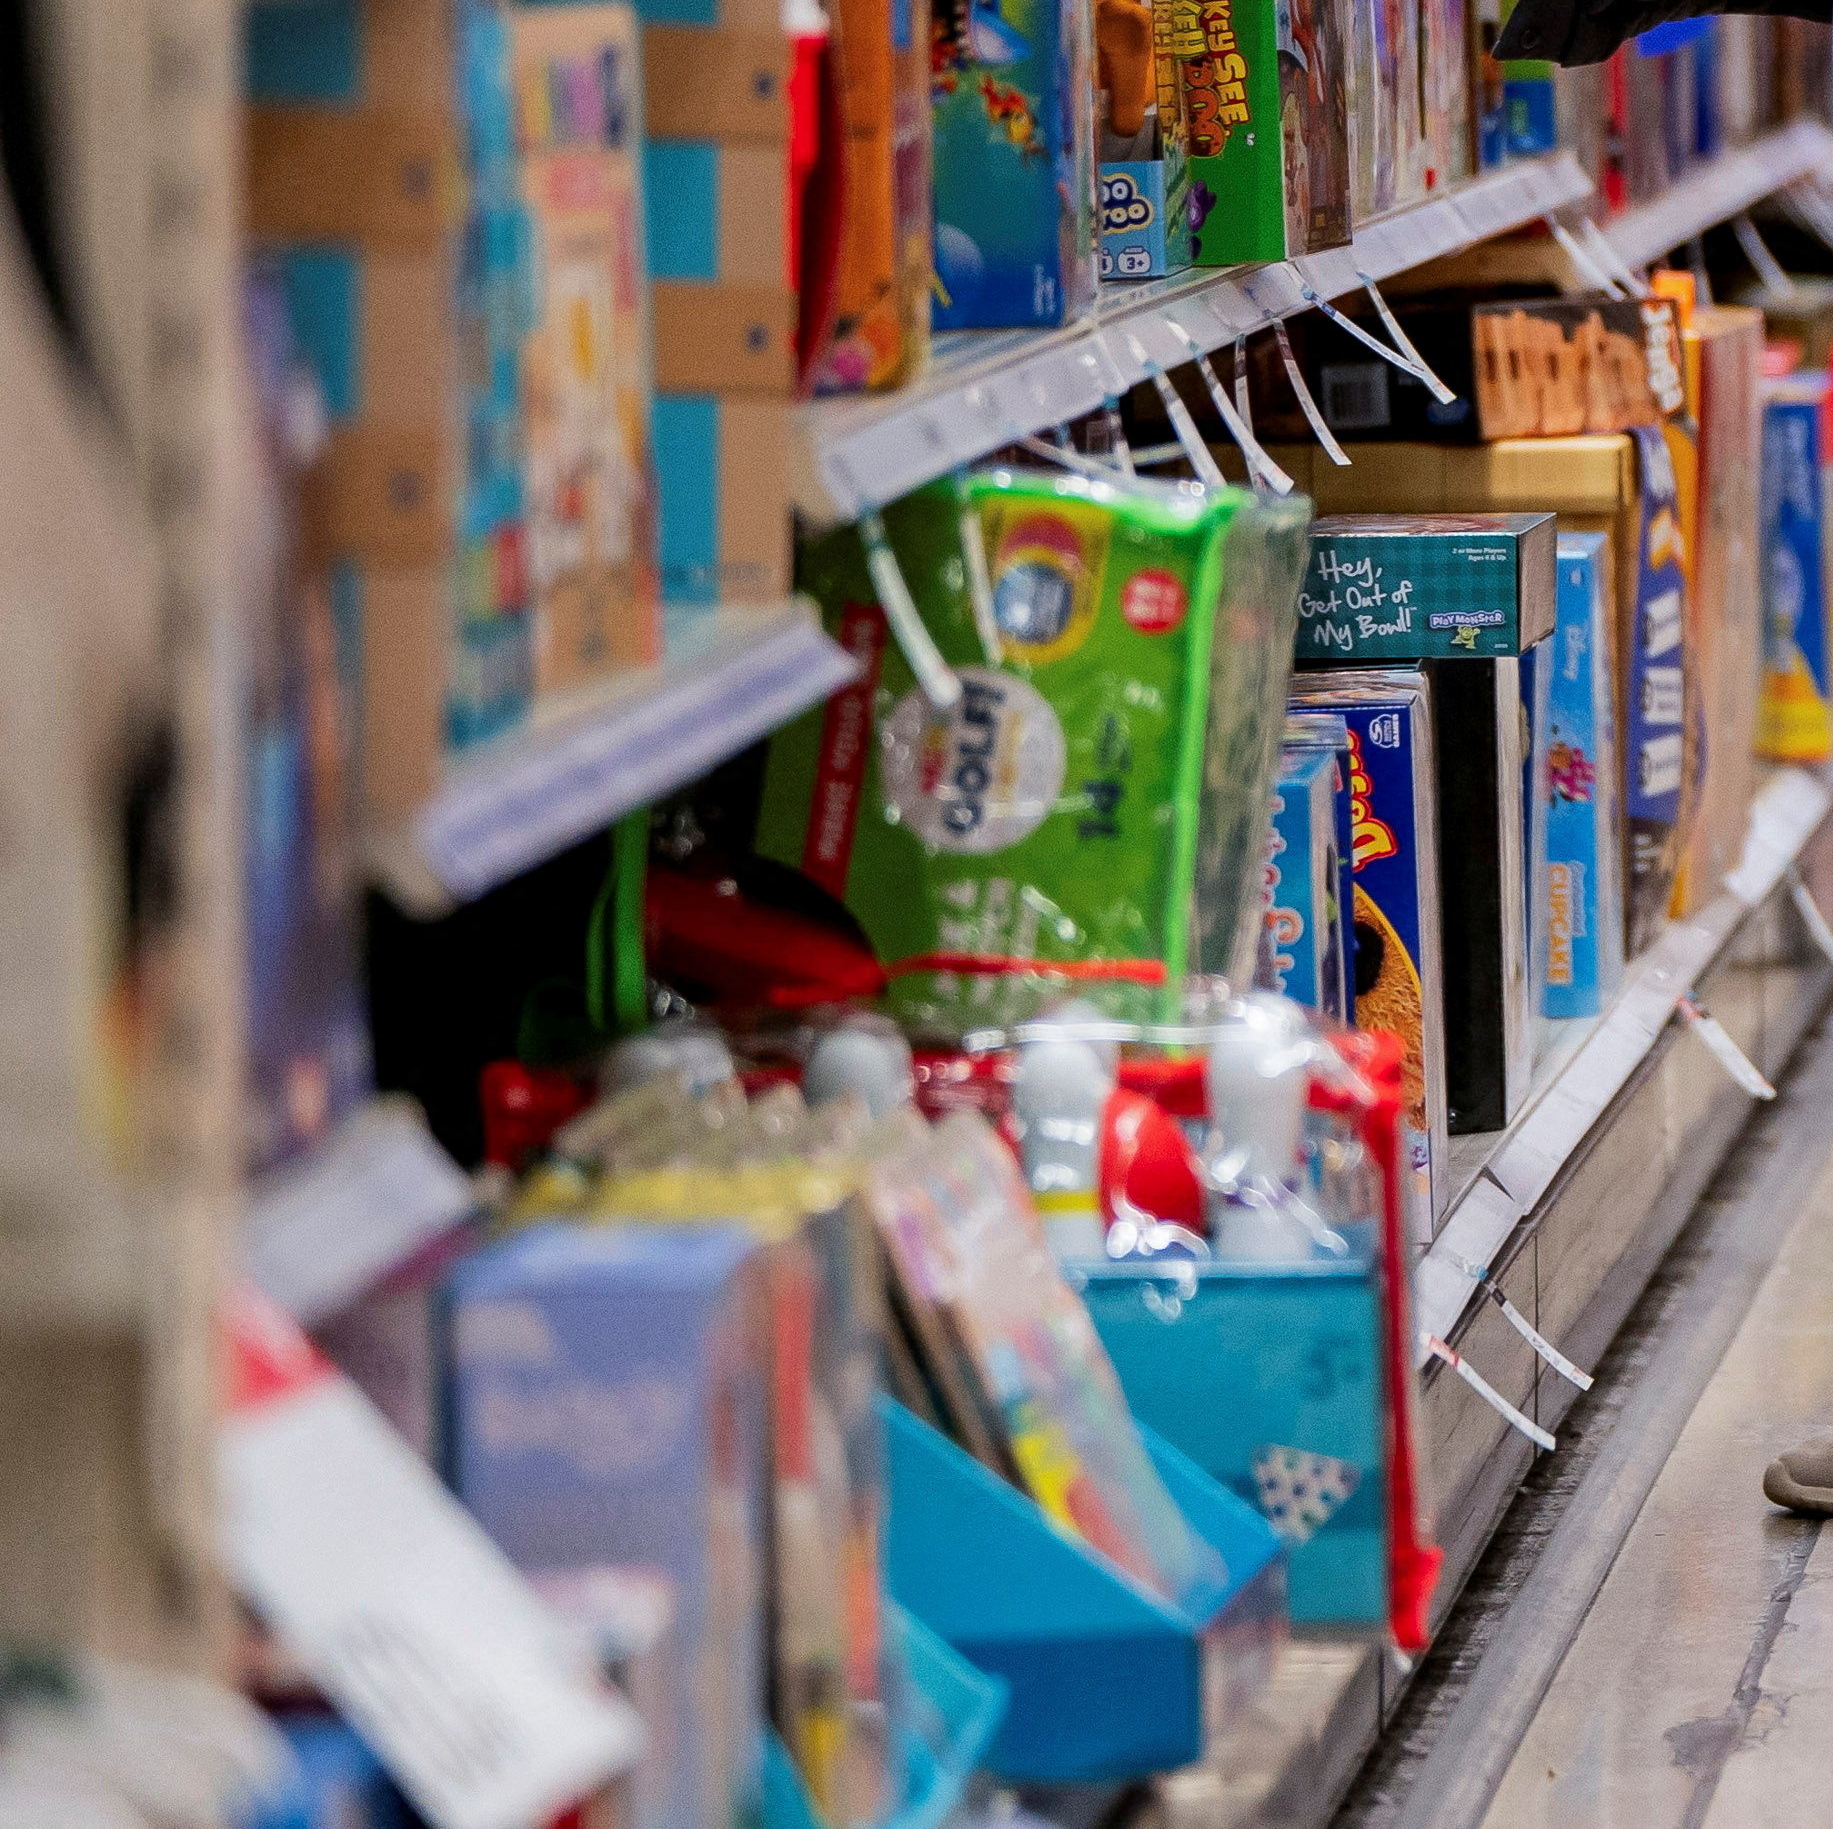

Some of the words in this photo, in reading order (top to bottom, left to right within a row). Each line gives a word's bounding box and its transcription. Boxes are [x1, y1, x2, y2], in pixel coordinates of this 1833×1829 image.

[1212, 52, 1250, 125] SEE
[1126, 256, 1145, 270] 3+
[1317, 549, 1383, 588] Hey,
[1299, 592, 1342, 619] Get
[1346, 583, 1388, 610] Out
[1390, 580, 1414, 606] of
[1314, 619, 1354, 651] My
[1358, 607, 1412, 640] Bowl!
